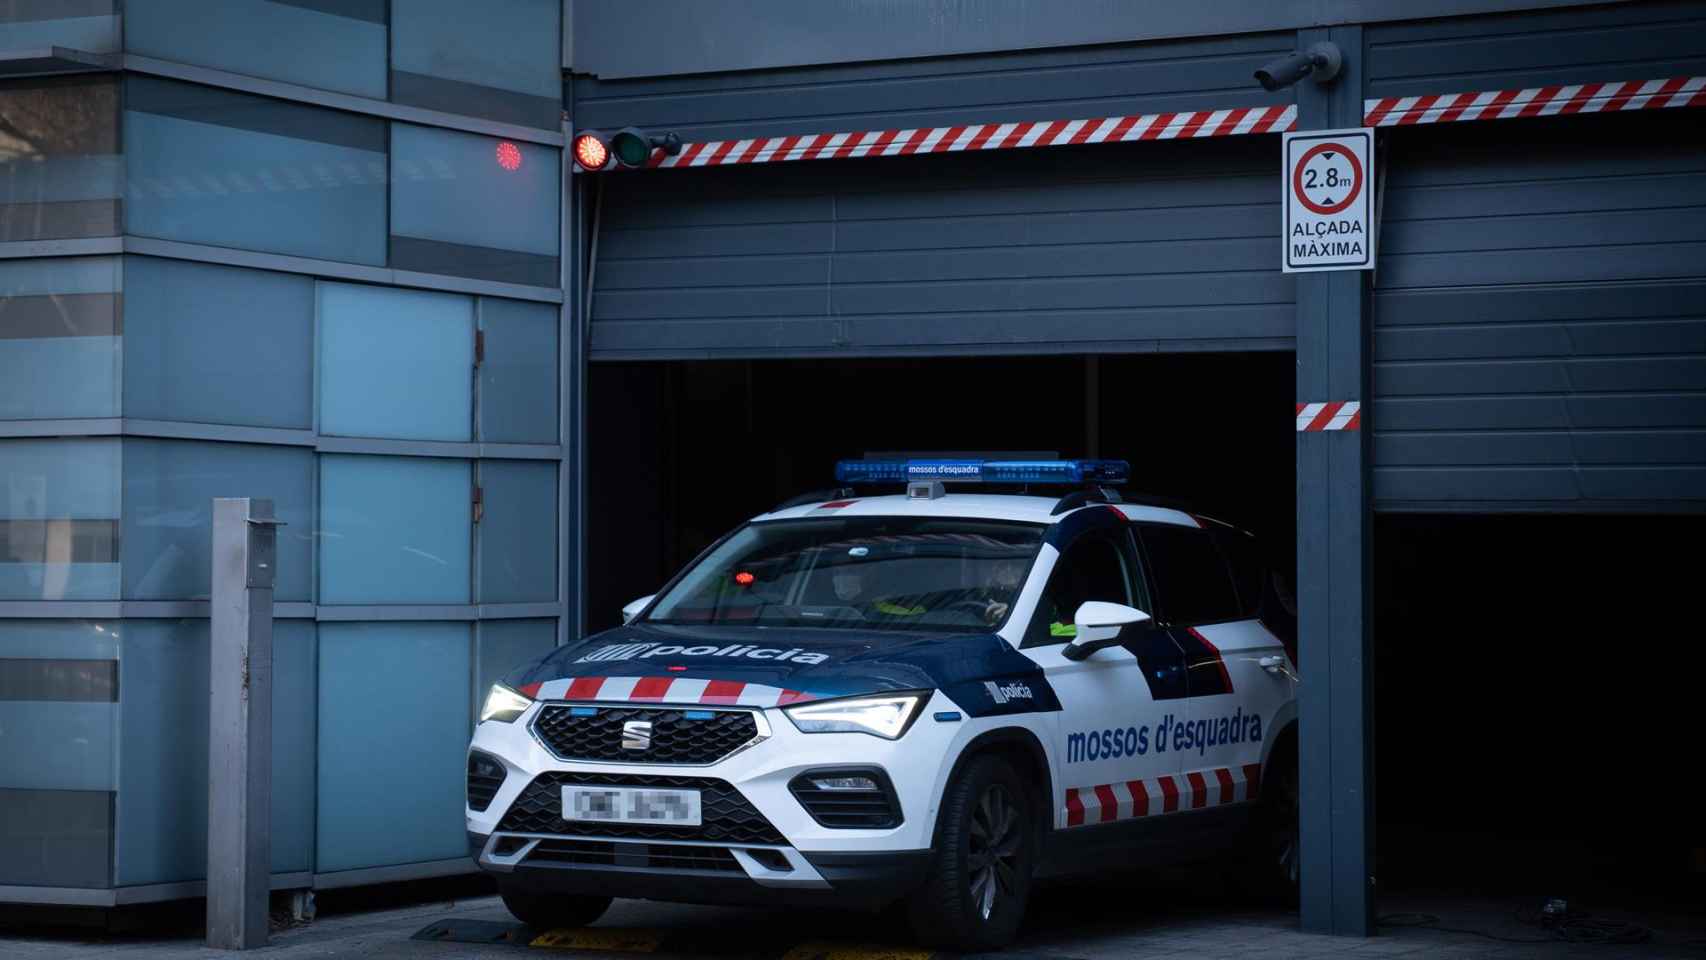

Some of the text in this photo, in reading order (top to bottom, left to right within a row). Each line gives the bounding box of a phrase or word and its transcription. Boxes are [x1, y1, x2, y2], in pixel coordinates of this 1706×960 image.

[1293, 220, 1363, 239] ALÇADA
[1293, 240, 1363, 258] MÀXIMA
[938, 465, 979, 474] d'esquadra
[639, 643, 829, 665] policia
[1000, 683, 1033, 702] policia
[1067, 706, 1262, 763] mossos d'esquadra
